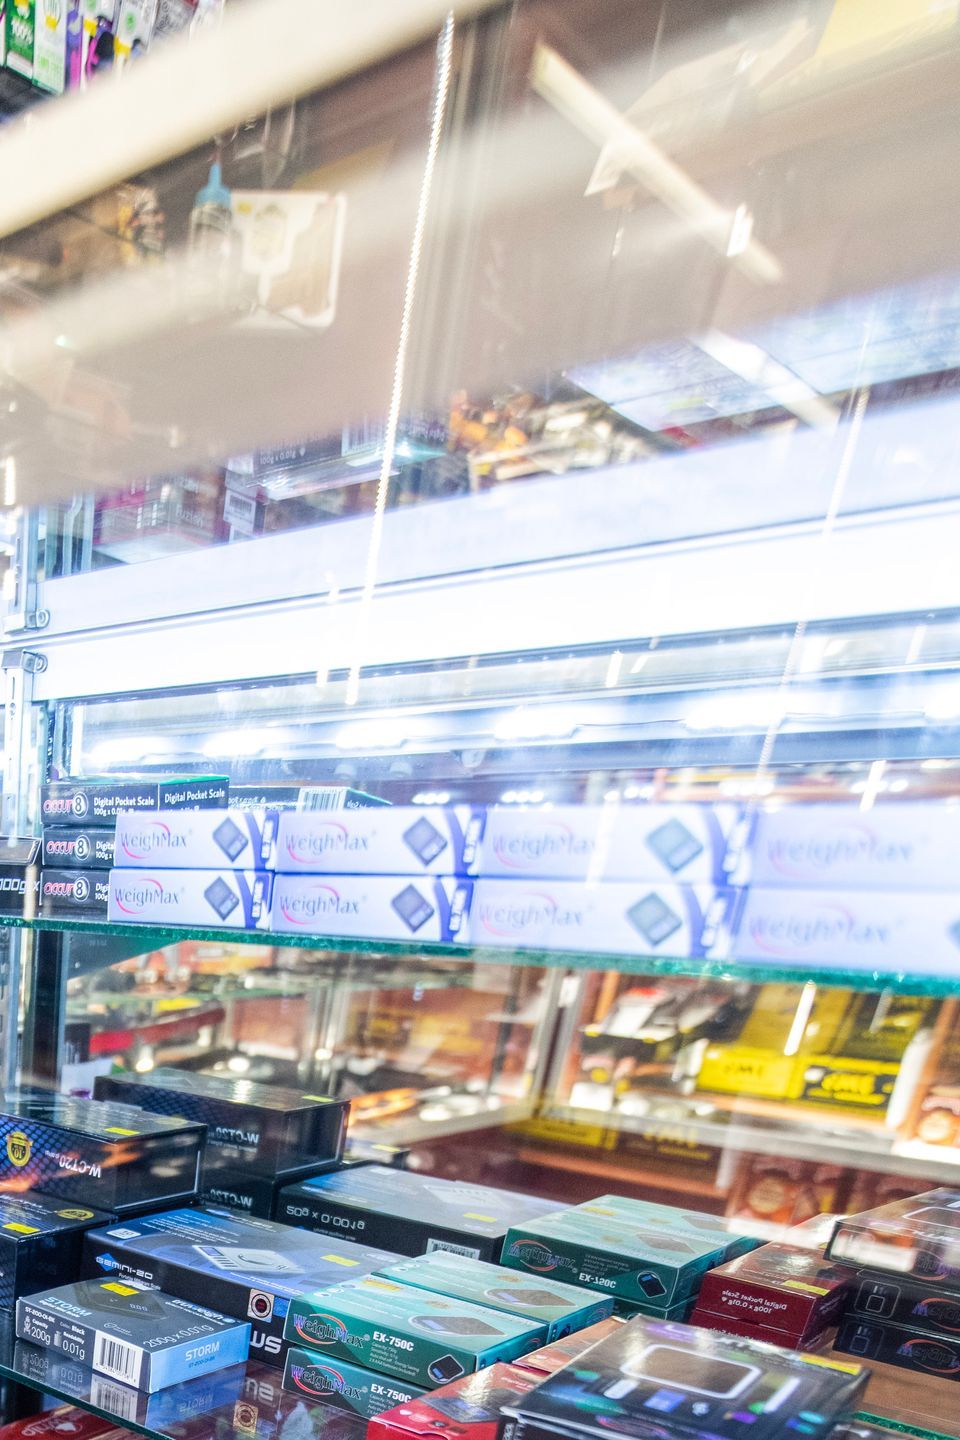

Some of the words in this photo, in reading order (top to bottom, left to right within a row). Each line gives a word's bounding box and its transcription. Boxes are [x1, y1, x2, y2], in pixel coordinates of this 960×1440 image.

[93, 796, 114, 807] Digital
[115, 796, 136, 806] Pocket
[136, 796, 155, 806] Scale
[164, 792, 186, 804] Digital
[186, 790, 207, 801] Pocket
[208, 788, 226, 799] Scale
[93, 807, 106, 817] 100g
[120, 830, 188, 854] WeighMax
[284, 830, 369, 857] WeighMax
[766, 828, 912, 865] WeighMax
[95, 851, 108, 860] 100g
[114, 888, 180, 911] WeighMax
[279, 893, 361, 917] WeighMax
[478, 901, 585, 929] WeighMax
[747, 909, 890, 948] WeighMax
[59, 1156, 102, 1178] W-CT20
[44, 1296, 92, 1317] STORM
[32, 1318, 48, 1329] Capacity
[71, 1325, 85, 1336] Black
[293, 1313, 365, 1348] WeighMax
[31, 1327, 51, 1346] 200g
[142, 1335, 174, 1349] 200g
[181, 1324, 214, 1338] 0.01g
[372, 1331, 415, 1352] EX-750C
[62, 1339, 85, 1360] 0.01g
[185, 1341, 220, 1361] STORM
[290, 1364, 362, 1400] WeighMax
[370, 1383, 412, 1403] EX-750C
